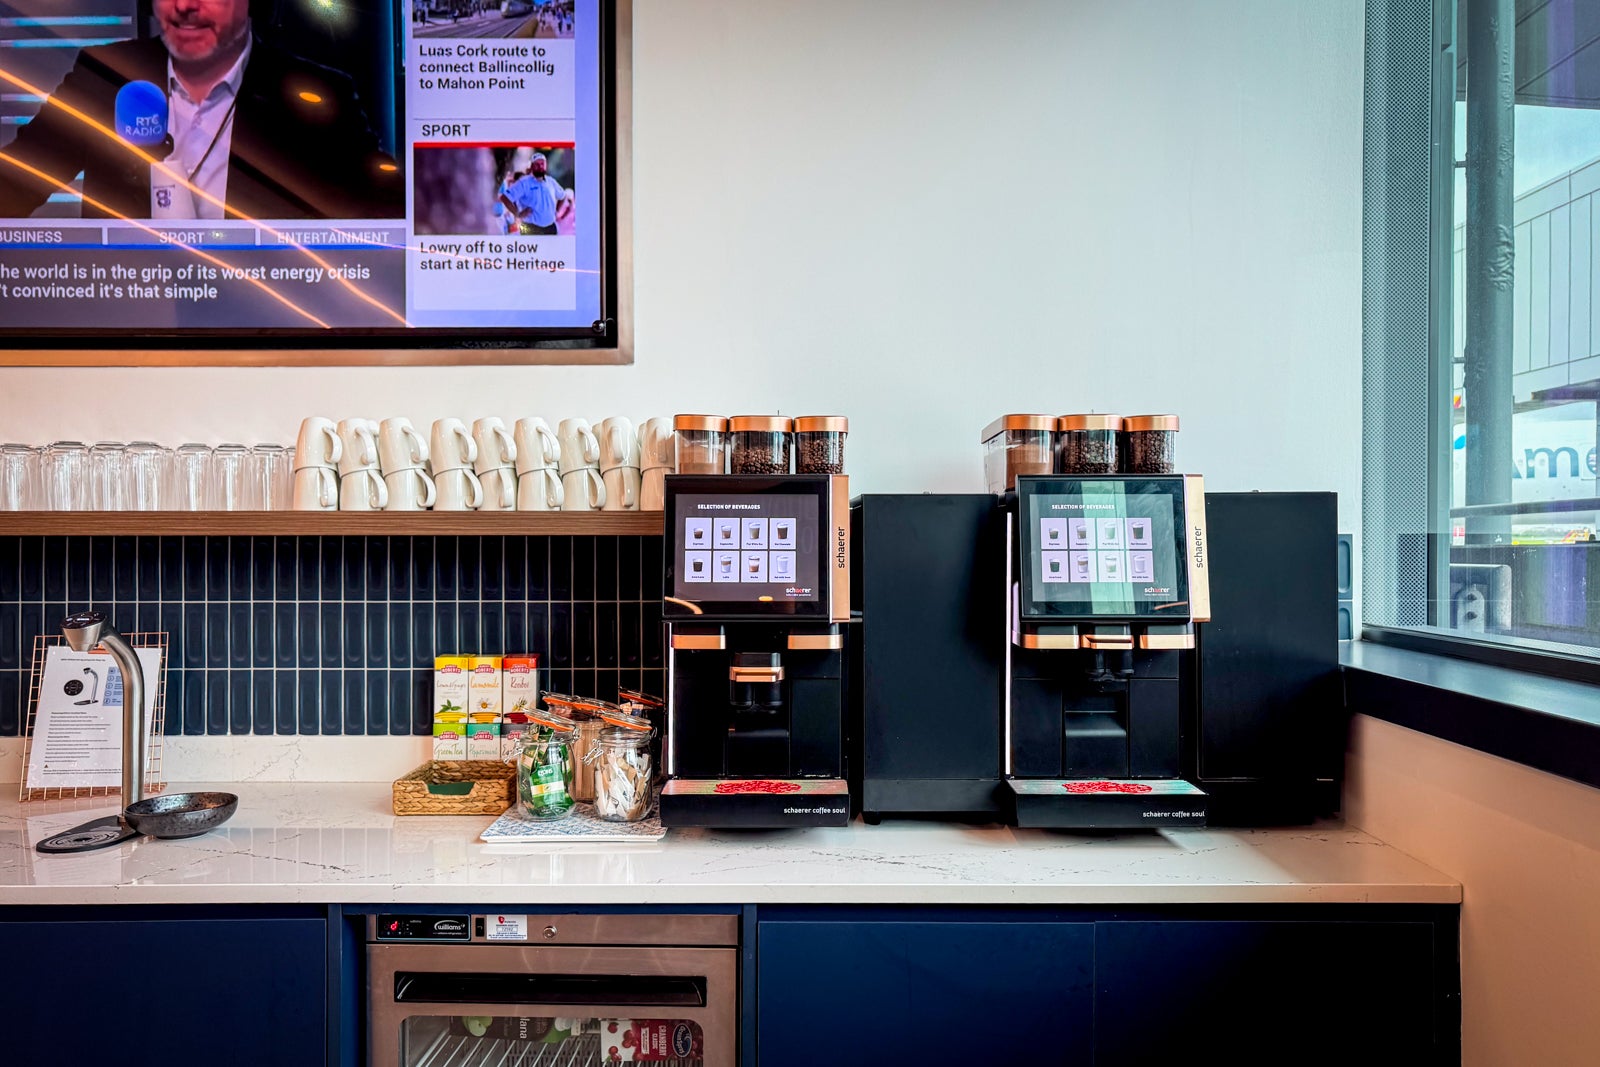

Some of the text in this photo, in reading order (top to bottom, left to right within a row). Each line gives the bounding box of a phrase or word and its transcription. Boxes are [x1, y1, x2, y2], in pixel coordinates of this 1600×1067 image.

[419, 44, 546, 57] Luas Cork route to
[419, 61, 555, 76] connect Ballincollig
[419, 77, 526, 89] to Mahon Point
[422, 124, 471, 136] SPORT
[159, 231, 205, 243] SPORT
[277, 231, 390, 244] ENTERTAINMENT
[420, 241, 538, 256] Lowry off to slow
[420, 257, 566, 272] start at RBC Heritage
[24, 263, 69, 280] world
[73, 264, 88, 280] is
[92, 264, 106, 279] in
[111, 264, 137, 280] the
[141, 264, 173, 283] grip
[176, 263, 193, 280] of
[197, 264, 217, 280] its
[221, 266, 267, 280] worst
[270, 267, 324, 283] energy
[327, 264, 371, 280] crisis
[12, 283, 95, 298] convinced
[100, 283, 123, 298] it's
[127, 283, 160, 298] that
[164, 283, 218, 302] simple
[835, 526, 846, 569] schaerer
[1193, 525, 1204, 569] schaerer
[783, 806, 846, 815] schaerer coffee soul
[1142, 810, 1205, 819] schaerer coffee soul
[519, 1016, 531, 1039] lana
